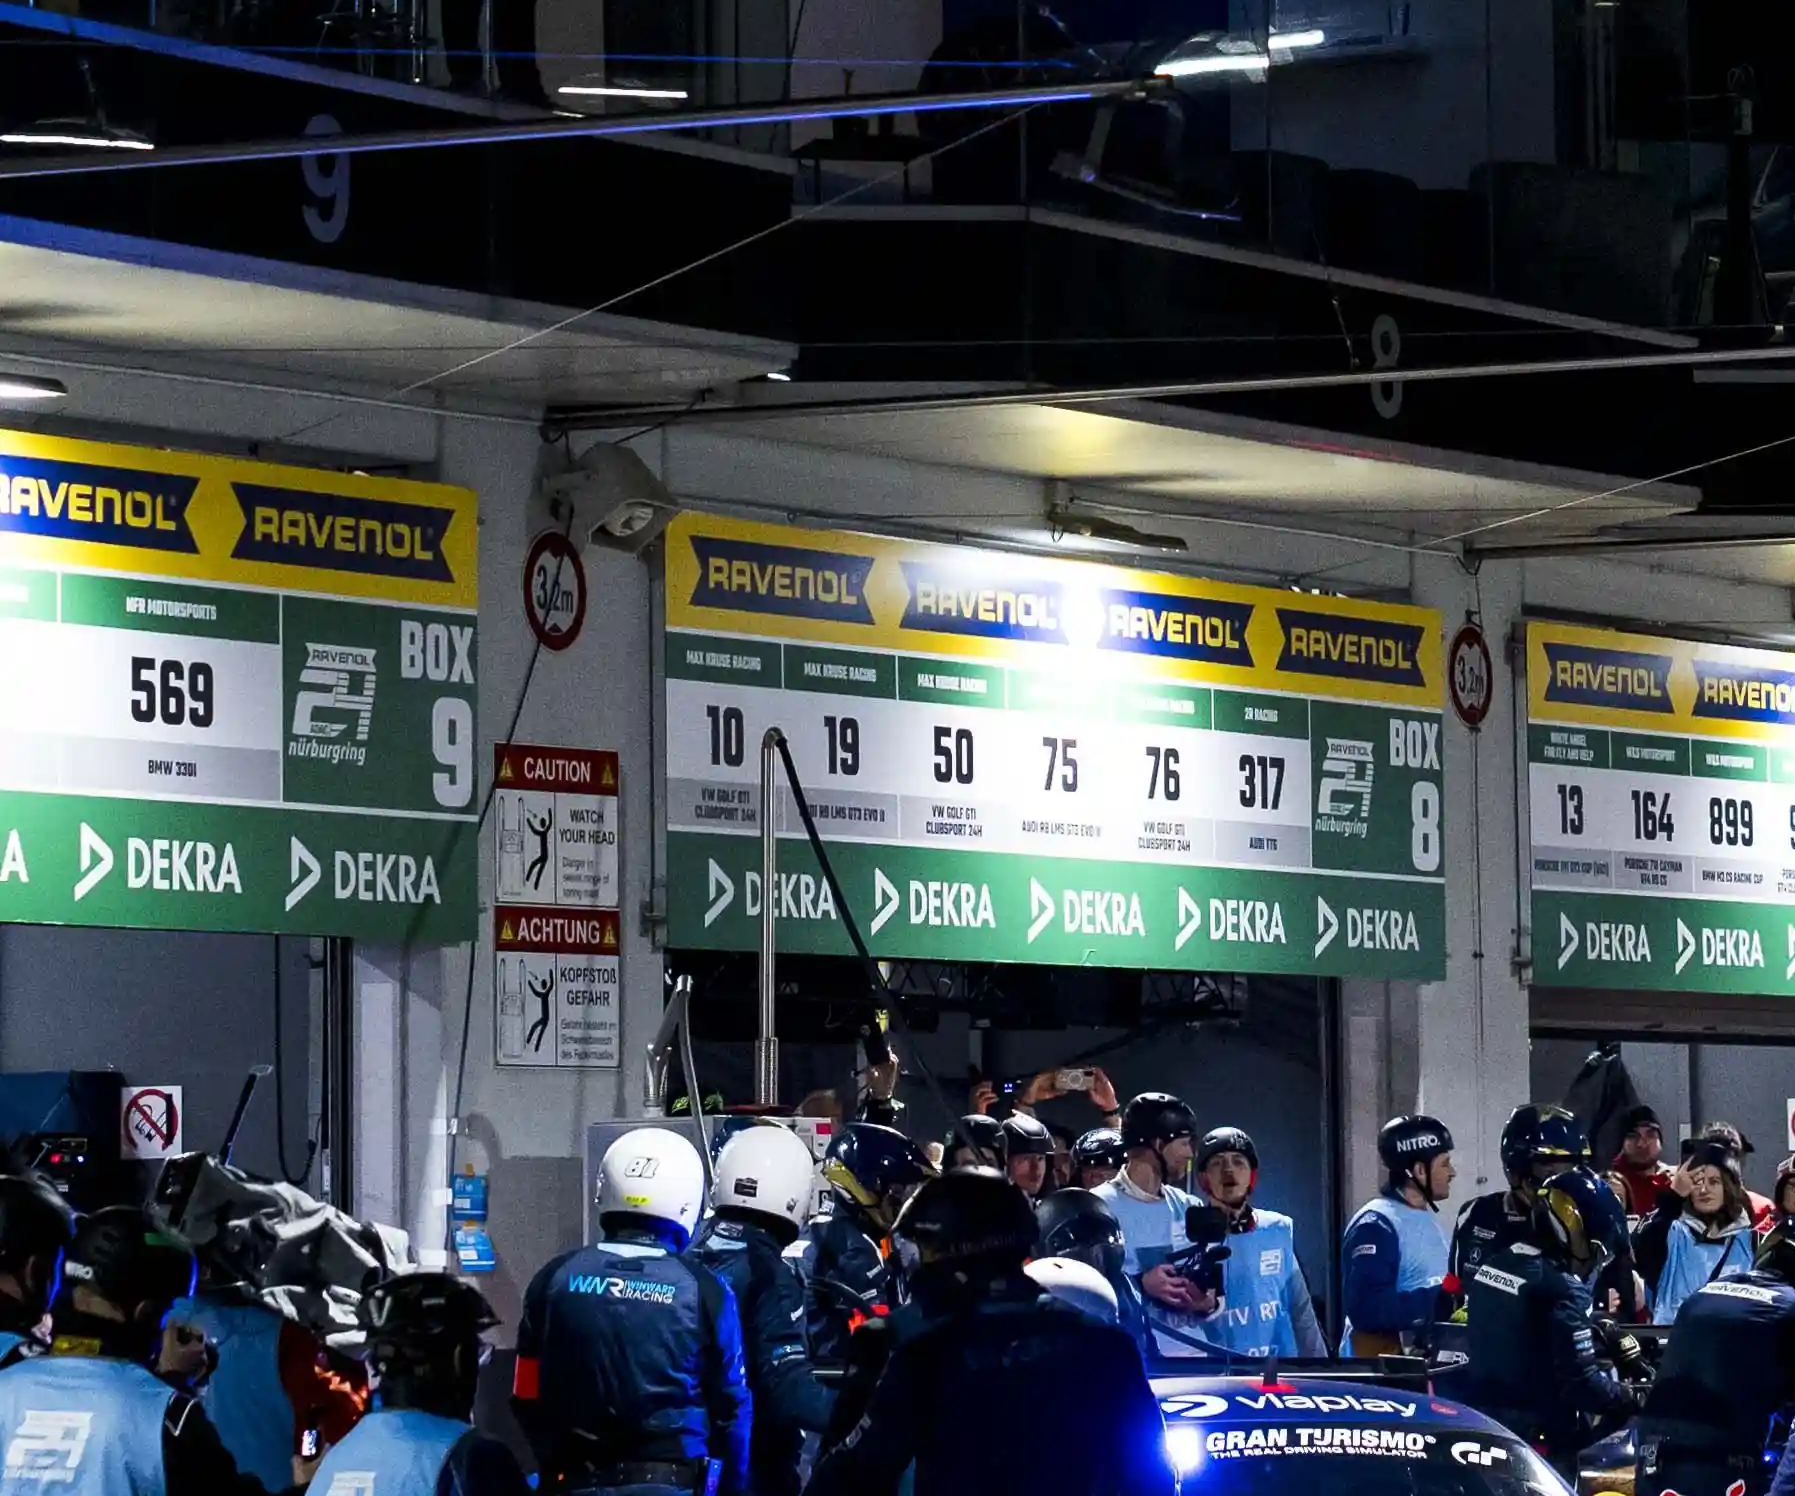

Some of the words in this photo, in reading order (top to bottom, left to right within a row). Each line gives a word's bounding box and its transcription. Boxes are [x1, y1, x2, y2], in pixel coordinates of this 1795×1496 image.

[300, 113, 353, 244] 9
[1370, 314, 1404, 421] 8
[254, 512, 434, 561] RAVENOL
[708, 557, 858, 605] RAVENOL
[916, 581, 1060, 630] RAVENOL
[1109, 604, 1240, 648] RAVENOL
[312, 649, 370, 666] RAVENOL
[401, 619, 475, 684] BOX
[686, 650, 704, 665] MAX
[804, 662, 821, 676] MAX
[1291, 628, 1412, 669] RAVENOL
[130, 656, 214, 728] 569
[1557, 661, 1661, 698] RAVENOL
[289, 738, 366, 765] nürburgring
[432, 697, 473, 808] 9
[706, 705, 744, 767] 10
[824, 716, 860, 776] 19
[933, 725, 974, 785] 50
[1389, 719, 1441, 771] BOX
[524, 757, 591, 783] CAUTION
[1042, 736, 1078, 793] 75
[1145, 746, 1180, 801] 76
[1239, 754, 1285, 810] 317
[570, 809, 604, 825] WATCH
[925, 821, 966, 836] CLUBSPORT
[968, 823, 983, 837] 24H
[932, 805, 945, 819] VW
[946, 806, 963, 820] GOLF
[965, 808, 976, 821] GTI
[1143, 821, 1156, 835] VW
[1157, 822, 1172, 835] GOLF
[1412, 781, 1441, 872] 8
[1557, 784, 1583, 835] 13
[1631, 790, 1674, 842] 164
[1709, 797, 1753, 847] 899
[559, 828, 586, 844] YOUR
[588, 830, 615, 845] HEAD
[1138, 837, 1176, 852] CLUBSPORT
[1177, 838, 1190, 852] 24H
[128, 837, 242, 894] DEKRA
[334, 851, 442, 904] DEKRA
[1702, 871, 1715, 881] BMW
[909, 880, 996, 930] DEKRA
[1063, 891, 1145, 938] DEKRA
[1210, 898, 1287, 944] DEKRA
[518, 917, 600, 945] ACHTUNG
[1347, 908, 1420, 952] DEKRA
[1587, 921, 1651, 963] DEKRA
[1703, 928, 1764, 968] DEKRA
[566, 989, 610, 1007] GEFAHR
[623, 1290, 673, 1304] RACING
[626, 1280, 675, 1296] WINWARD
[1225, 1307, 1249, 1326] TV
[1206, 1428, 1288, 1451] GRAN
[1299, 1428, 1425, 1449] TURISMO
[1211, 1452, 1239, 1460] THE
[1244, 1448, 1281, 1457] REAL
[1284, 1446, 1344, 1455] DRIVING
[1347, 1447, 1427, 1459] SIMULATOR
